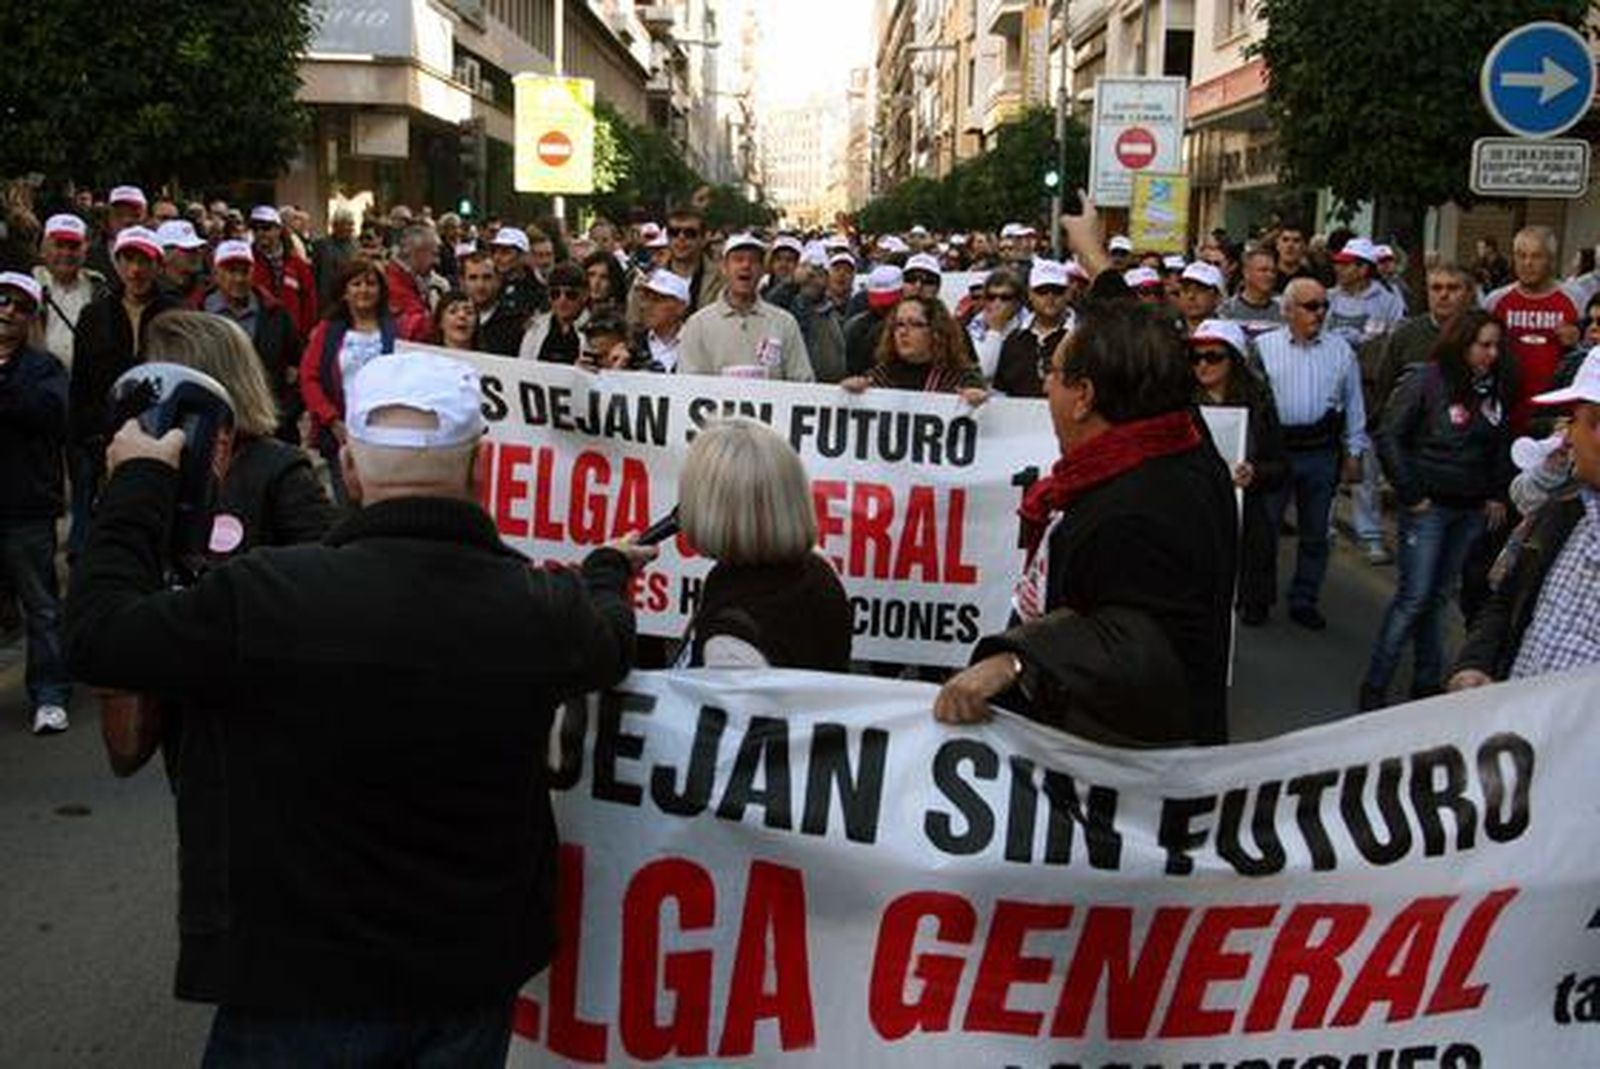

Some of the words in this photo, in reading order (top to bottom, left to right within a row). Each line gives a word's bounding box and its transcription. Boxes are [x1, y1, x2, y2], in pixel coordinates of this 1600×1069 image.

[519, 380, 670, 447] DEJAN
[789, 404, 977, 468] FUTURO
[924, 738, 1122, 870] SIN
[1158, 731, 1535, 877] FUTURO
[513, 844, 816, 1063] LGA
[868, 887, 1520, 1042] GENERAL
